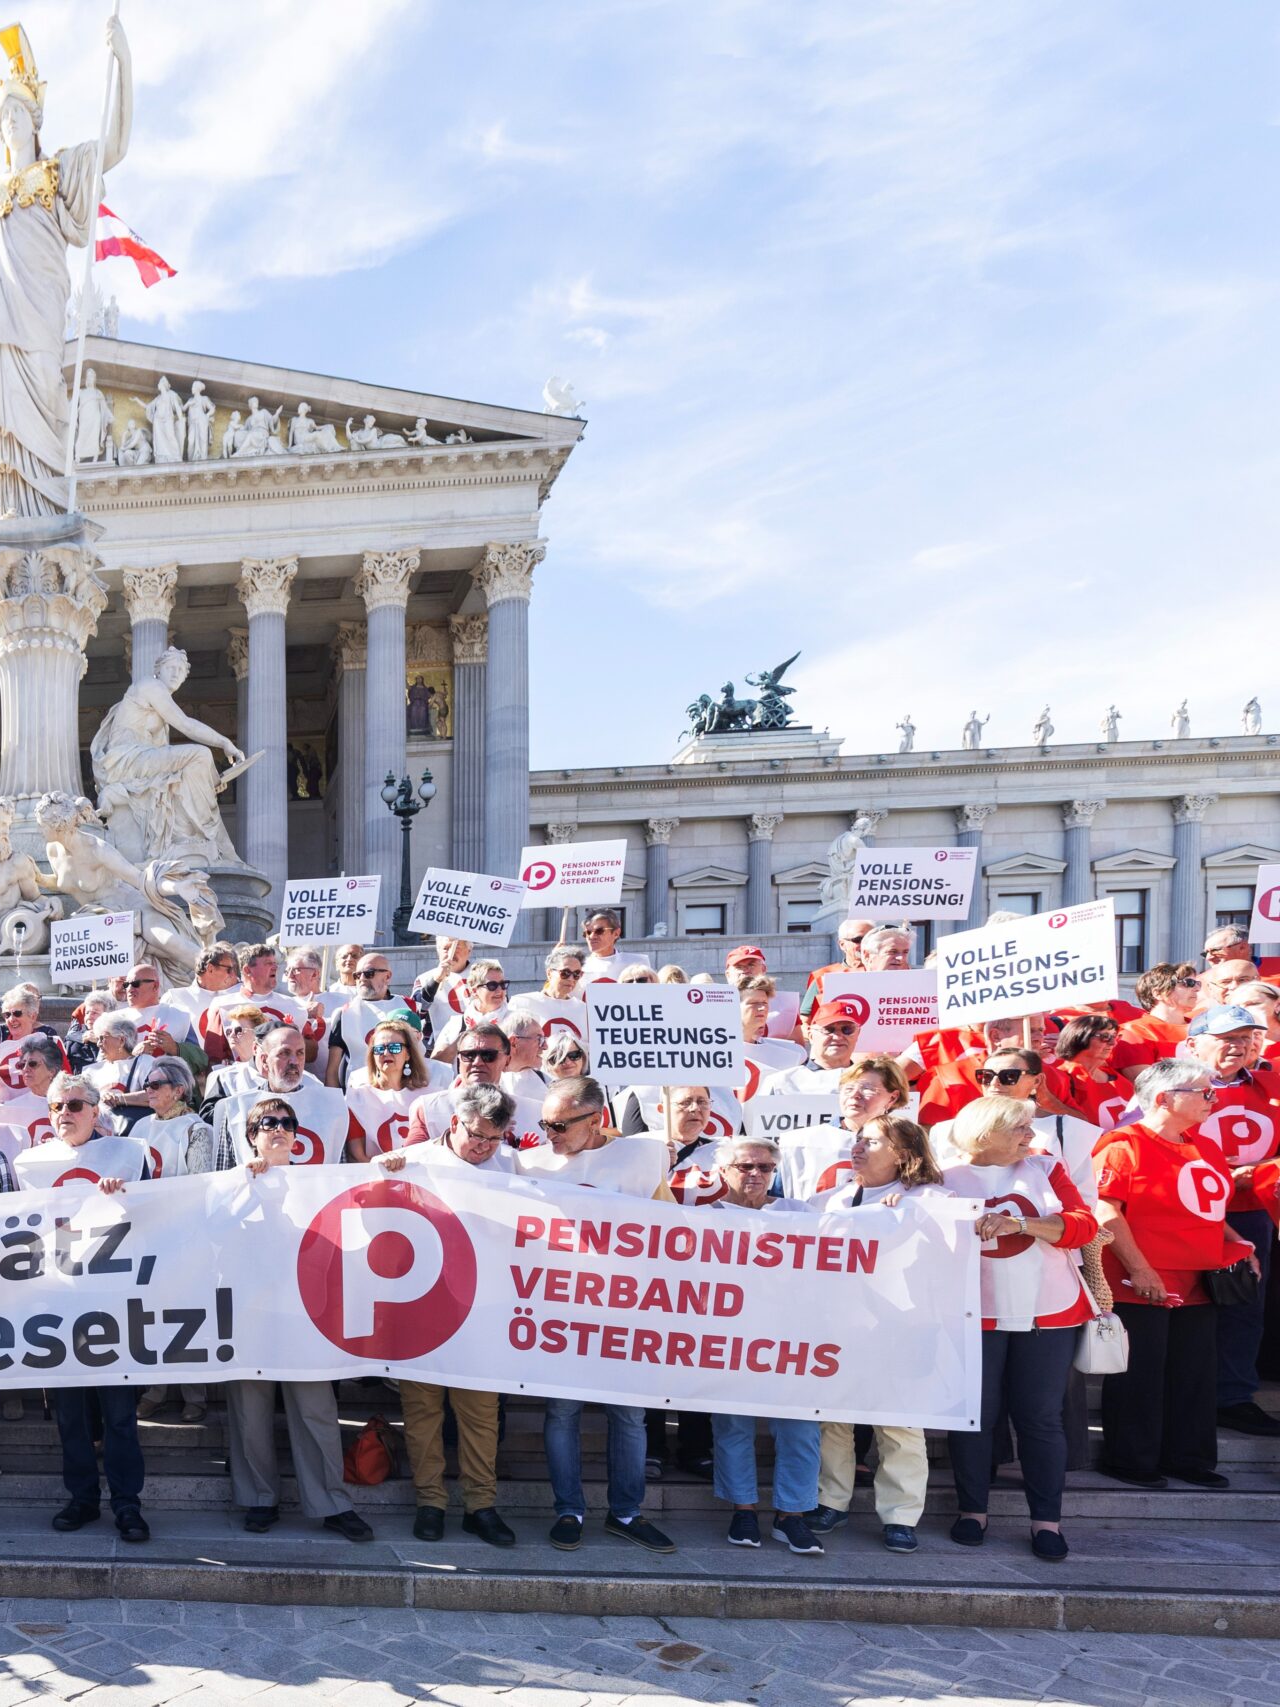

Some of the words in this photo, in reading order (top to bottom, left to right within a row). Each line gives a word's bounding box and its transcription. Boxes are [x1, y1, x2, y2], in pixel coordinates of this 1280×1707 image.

[561, 868, 600, 877] VERBAND
[562, 860, 622, 869] PENSIONISTEN
[860, 863, 913, 876] VOLLE
[426, 879, 472, 897] VOLLE
[560, 875, 616, 885] ÖSTERREICHS
[858, 878, 951, 891] PENSIONS-
[288, 888, 338, 903] VOLLE
[854, 894, 964, 906] ANPASSUNG!
[286, 904, 373, 920] GESETZES-
[422, 894, 512, 920] TEUERUNGS-
[285, 922, 340, 937] TREUE!
[415, 908, 505, 935] ABGELTUNG!
[54, 929, 90, 944] VOLLE
[55, 940, 119, 958] PENSIONS-
[945, 940, 1018, 969] VOLLE
[55, 952, 129, 972] ANPASSUNG!
[946, 950, 1081, 990] PENSIONS-
[946, 965, 1105, 1010] ANPASSUNG!
[594, 1004, 664, 1022] VOLLE
[878, 1006, 930, 1015] VERBAND
[877, 1016, 939, 1026] ÖSTERREIC
[596, 1027, 737, 1045] TEUERUNGS-
[597, 1051, 733, 1069] ABGELTUNG!
[514, 1214, 879, 1275] PENSIONISTEN
[509, 1264, 745, 1318] VERBAND
[508, 1306, 843, 1378] ÖSTERREICHS
